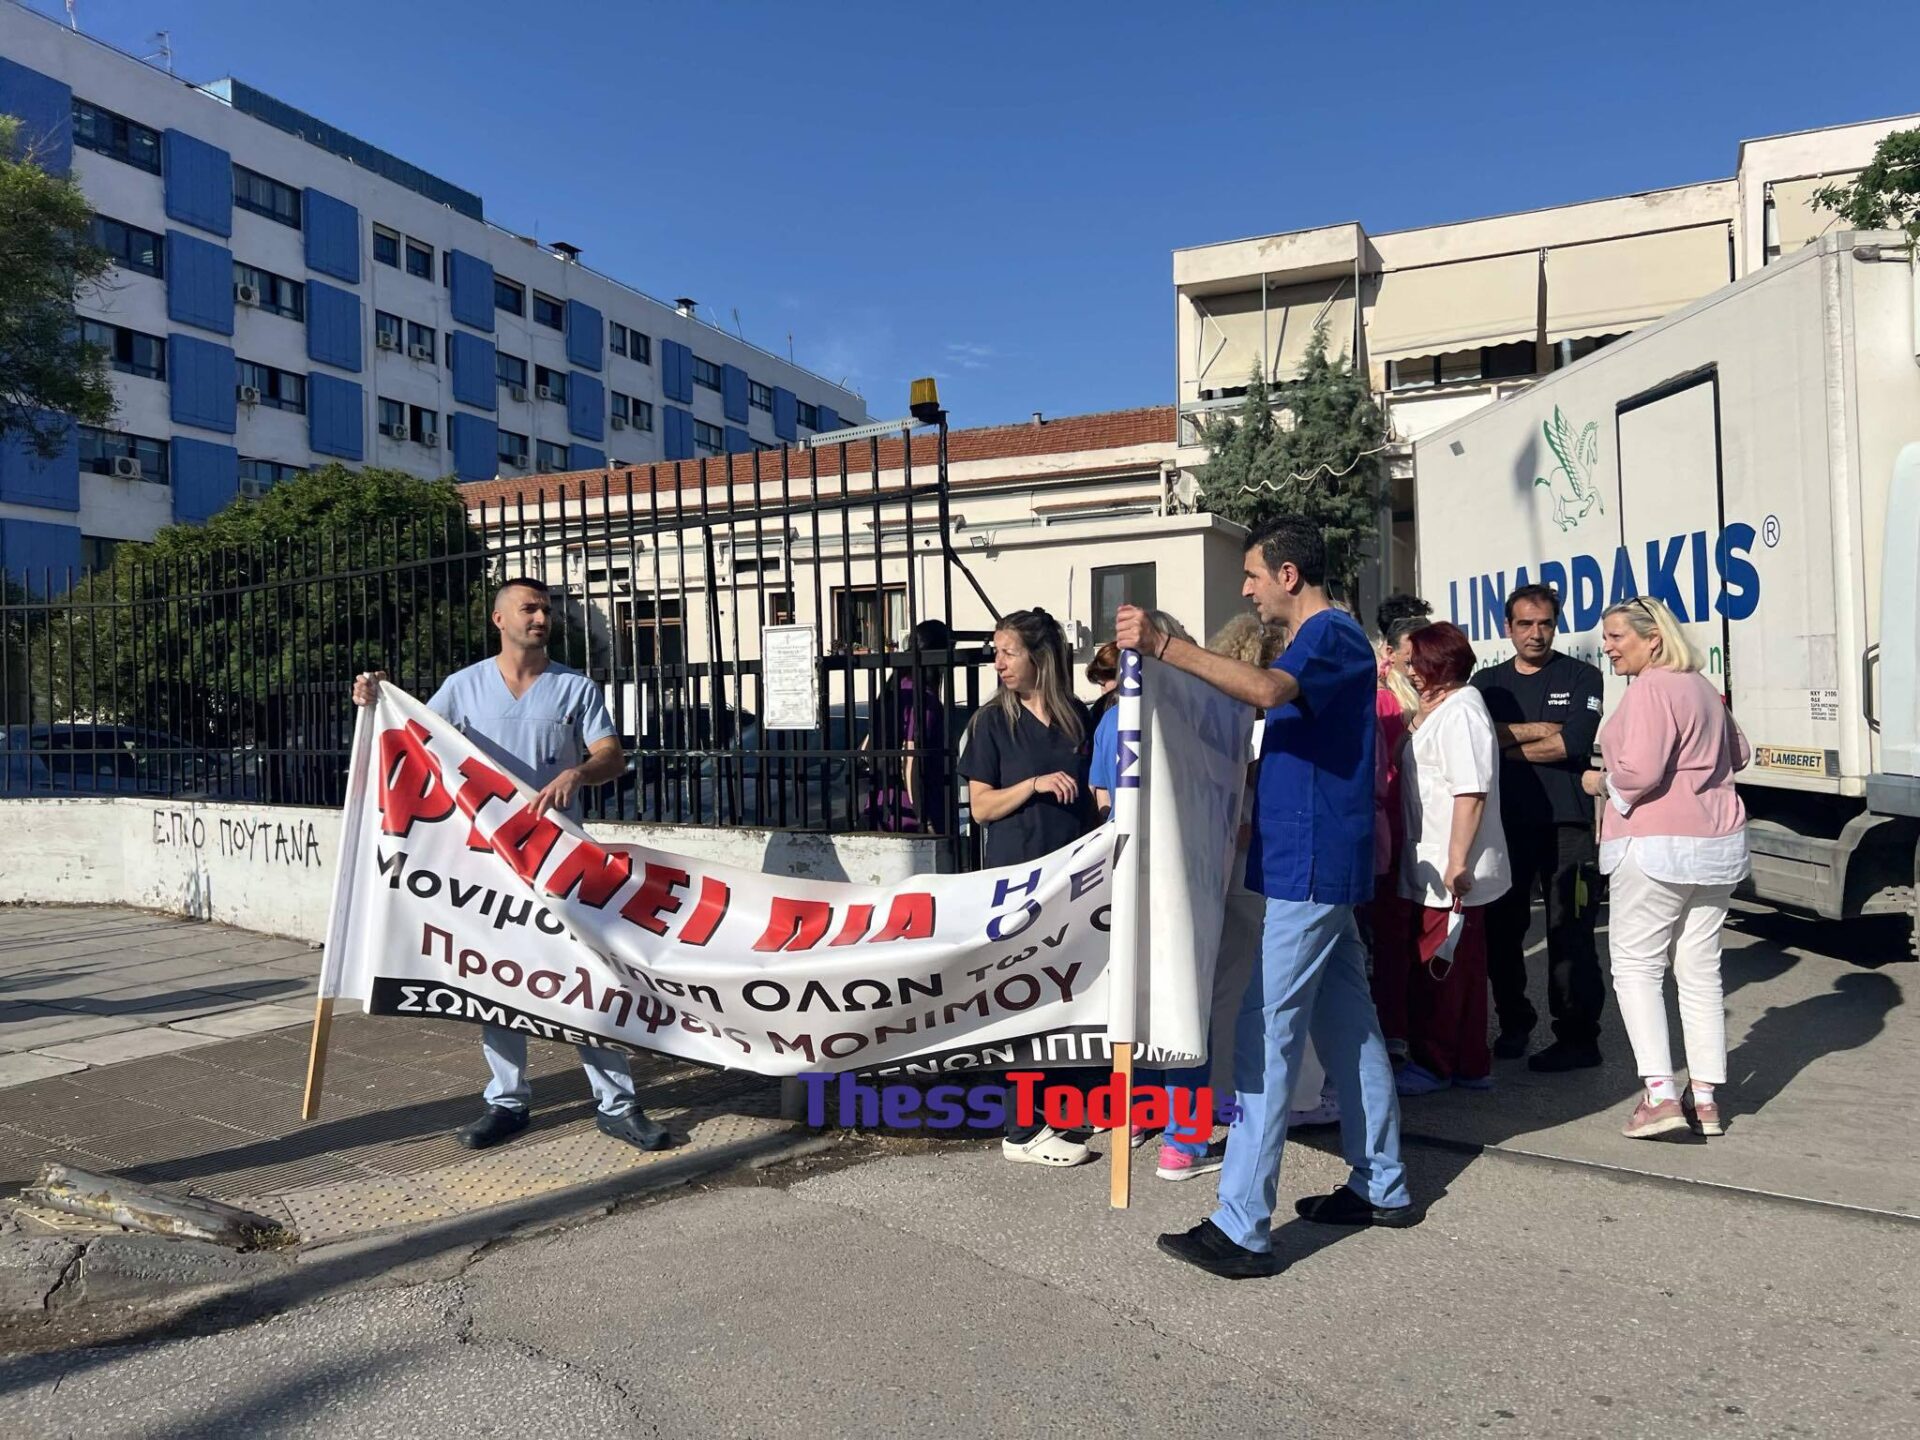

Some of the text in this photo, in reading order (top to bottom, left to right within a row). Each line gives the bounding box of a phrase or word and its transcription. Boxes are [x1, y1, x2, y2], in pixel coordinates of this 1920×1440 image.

[1770, 752, 1822, 768] LAMBERET
[220, 818, 322, 867] ΠΟΥΤΑΝΑ
[379, 718, 731, 947] ΦΤΑΝΕΙ
[752, 892, 936, 952] ΠΙΑ
[421, 922, 1082, 1063] Προσλήψεις ΜΟΝΙΜΟΥ
[742, 972, 943, 1012] ΟΛΩΝ
[966, 924, 1069, 982] των
